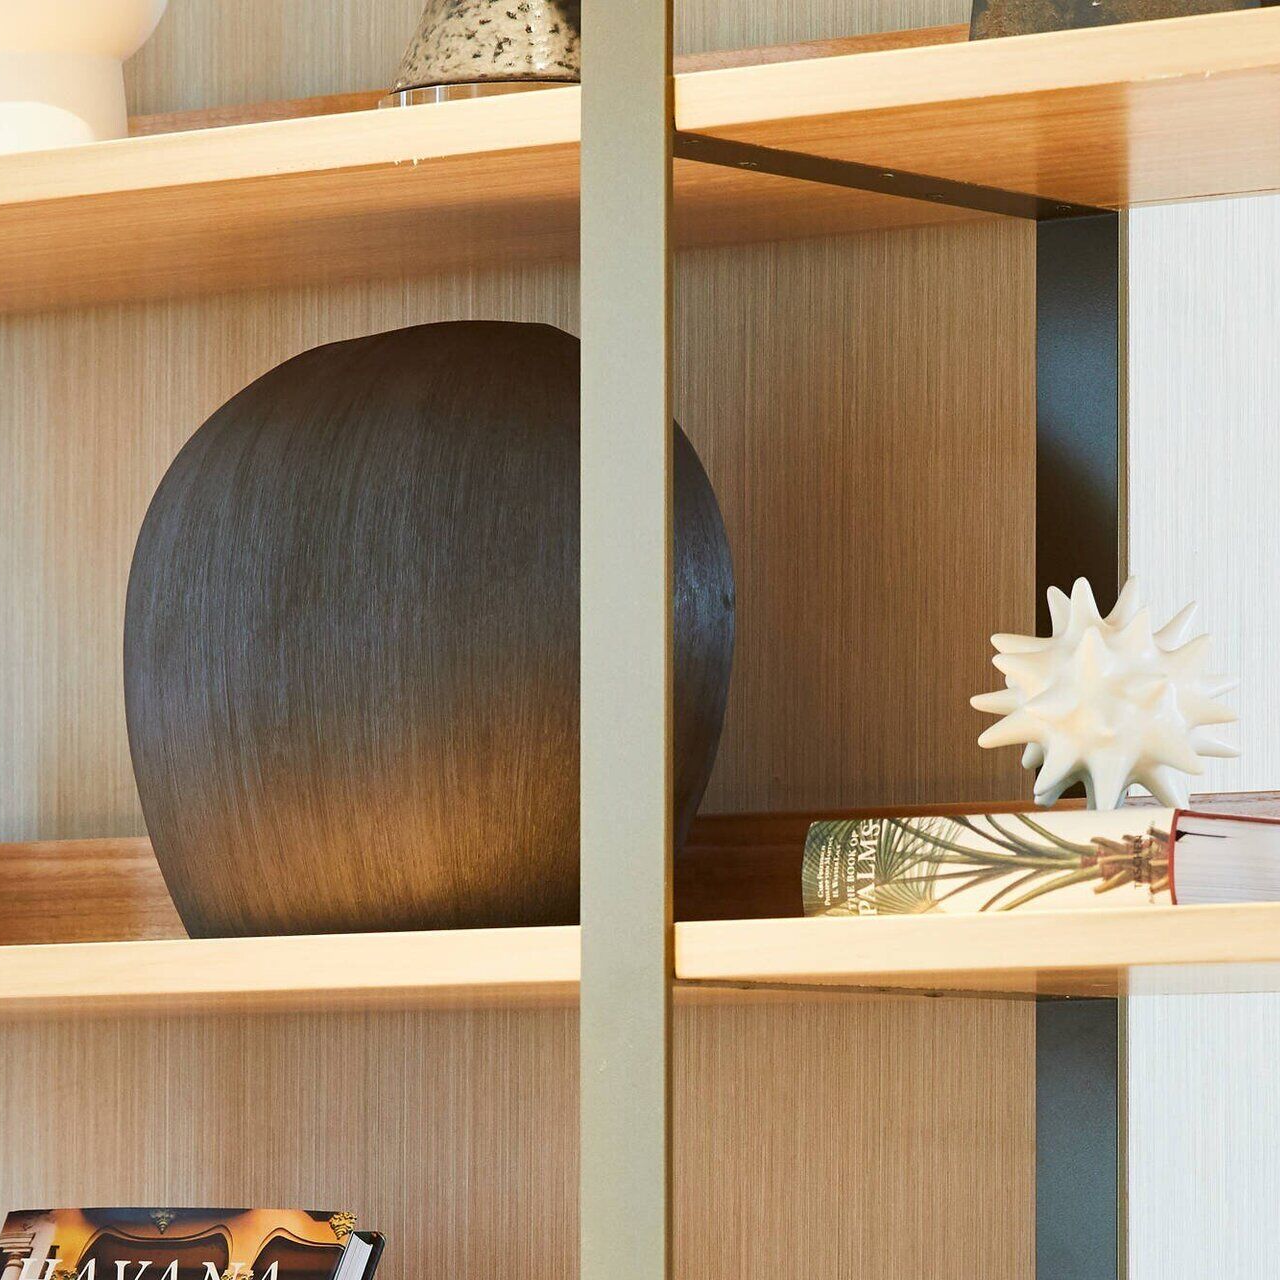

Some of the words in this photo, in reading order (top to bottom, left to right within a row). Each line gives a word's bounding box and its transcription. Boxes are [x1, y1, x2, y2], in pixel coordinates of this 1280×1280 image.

[850, 829, 859, 846] OF
[847, 849, 856, 882] BOOK
[857, 819, 880, 915] PALMS
[847, 885, 857, 910] THE
